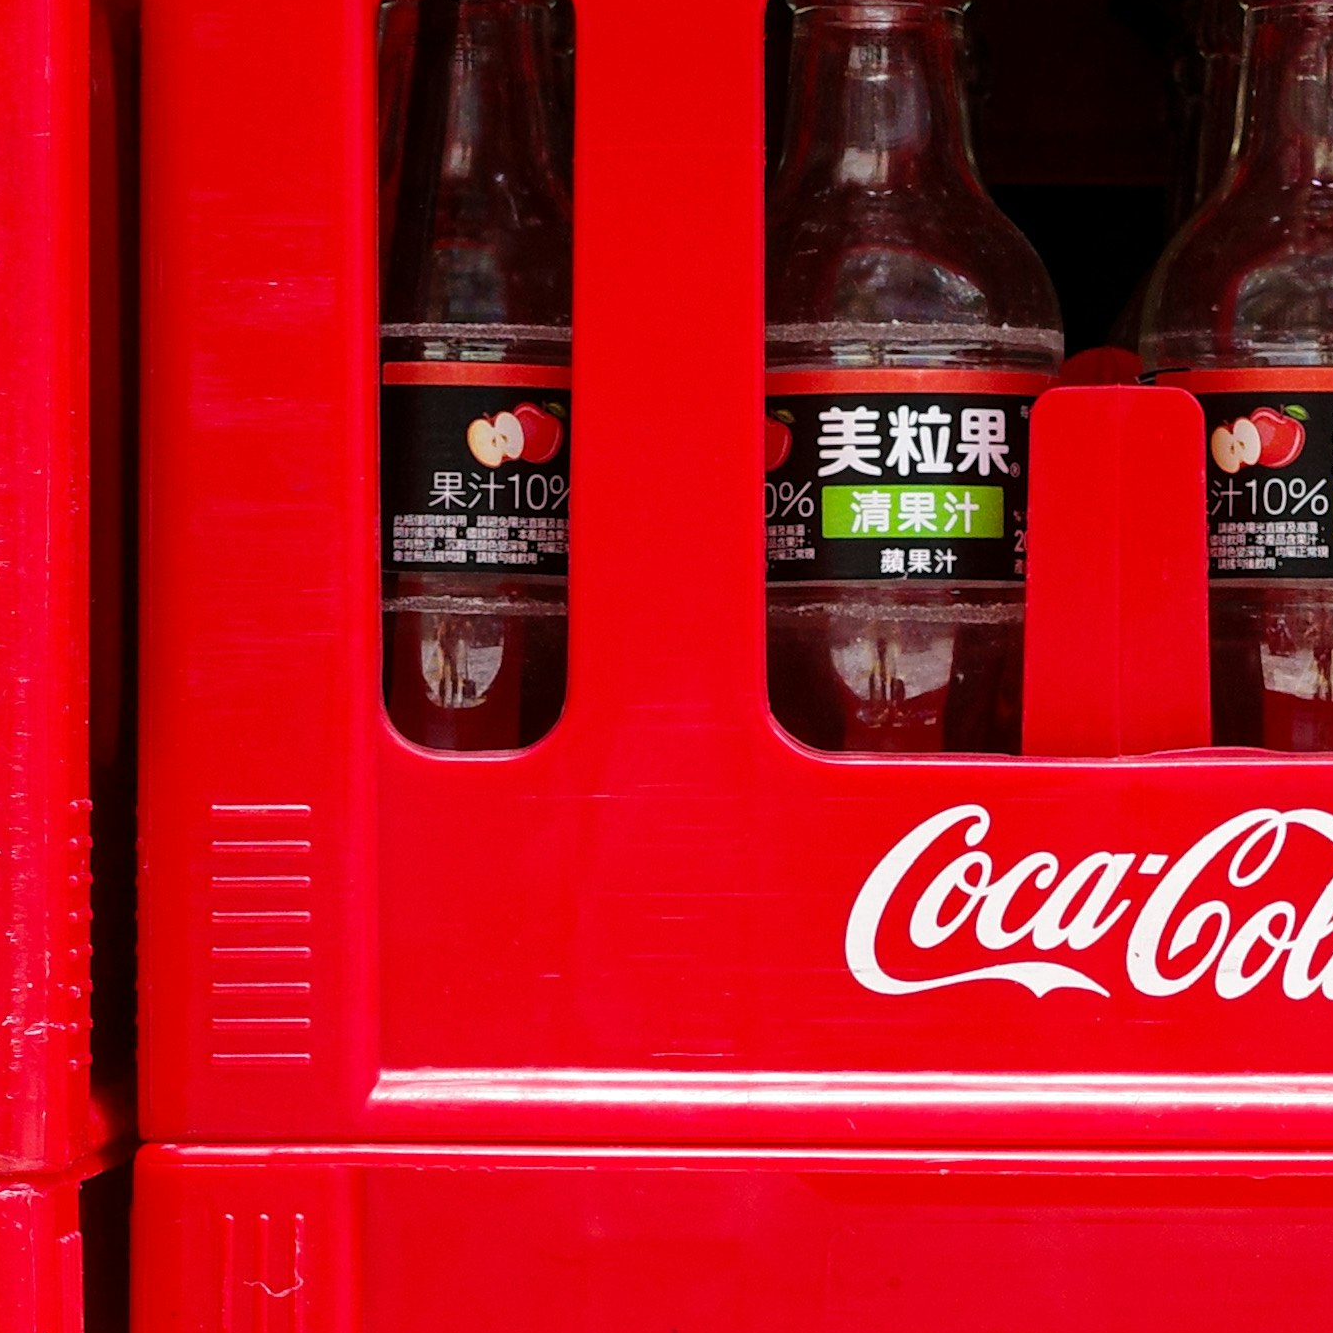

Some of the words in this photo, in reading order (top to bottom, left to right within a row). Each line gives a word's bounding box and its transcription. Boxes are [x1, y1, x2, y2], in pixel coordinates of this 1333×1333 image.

[817, 405, 1010, 478] 美粒果
[850, 490, 980, 534] 清果汁
[1206, 478, 1329, 517] 汁10%
[880, 548, 958, 574] 蘋果汁
